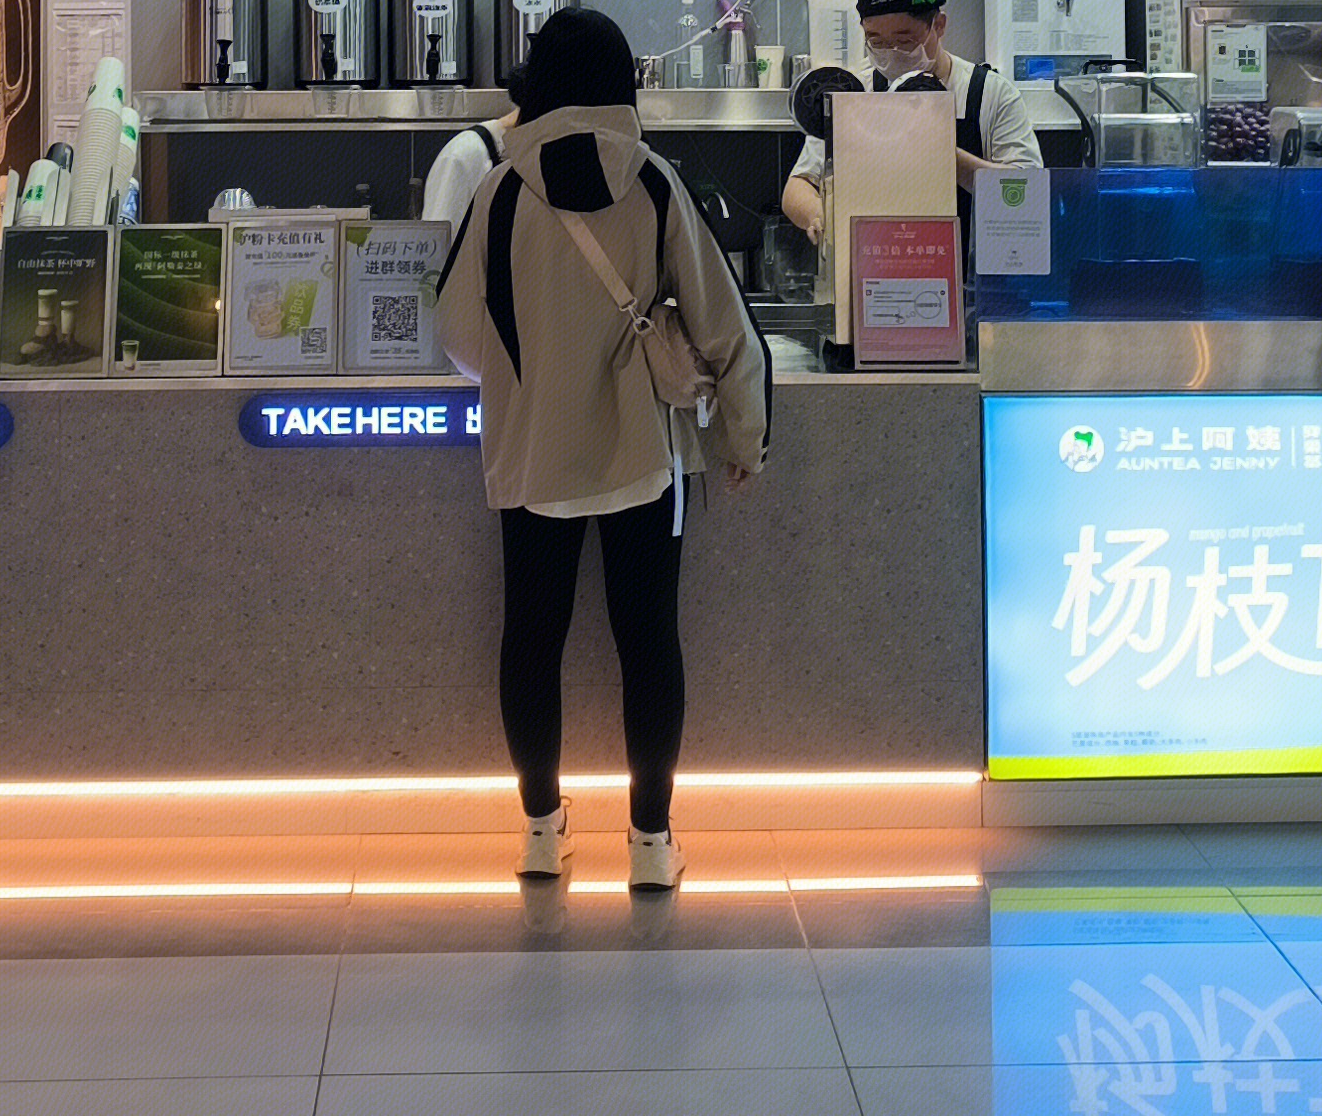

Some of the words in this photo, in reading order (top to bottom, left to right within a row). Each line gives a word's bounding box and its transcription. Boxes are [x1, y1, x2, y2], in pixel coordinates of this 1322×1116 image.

[364, 260, 427, 275] 进群领券
[1117, 426, 1282, 452] 沪上阿姨
[1116, 456, 1201, 471] AUNTEA
[1209, 456, 1280, 471] JENNY
